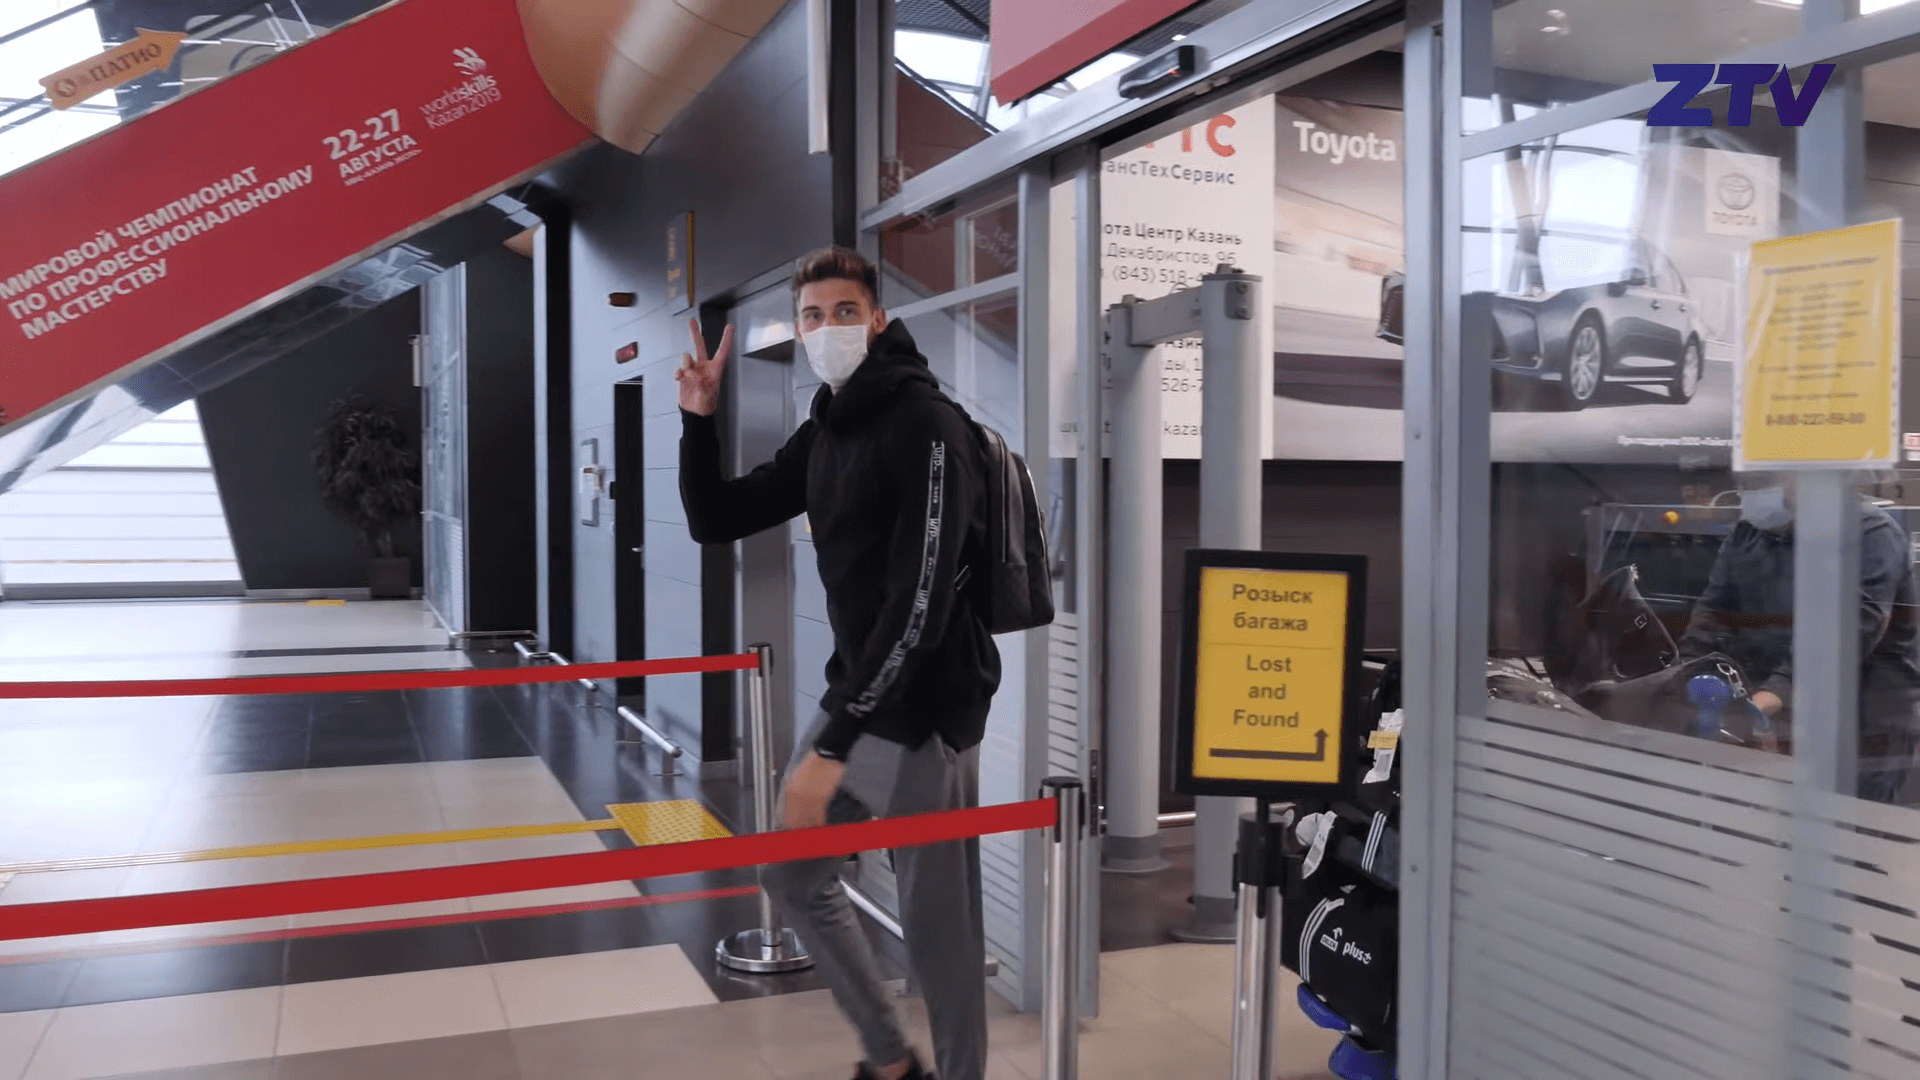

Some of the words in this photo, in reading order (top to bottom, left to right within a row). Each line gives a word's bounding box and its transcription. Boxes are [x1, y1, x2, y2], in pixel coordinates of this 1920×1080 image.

[90, 43, 162, 82] ПАТИО
[419, 75, 497, 115] worldskills
[322, 108, 400, 160] 22-27
[1293, 120, 1397, 164] Toyota
[339, 135, 418, 178] АВГУСТА
[1101, 160, 1235, 185] ансТехСервис
[0, 230, 119, 300] МИРОВОЙ
[117, 166, 260, 240] ЧЕМПИОНАТ
[8, 292, 48, 320] ПО
[47, 165, 314, 301] ПРОФЕССИОНАЛЬНОМУ
[1101, 223, 1131, 236] ота
[1135, 222, 1184, 244] Центр
[1187, 227, 1242, 245] Казань
[1112, 265, 1156, 283] (843)
[20, 258, 168, 339] МАСТЕРСТВУ
[1163, 420, 1202, 436] kaza
[1231, 583, 1314, 603] Розыск
[1233, 611, 1309, 631] багажа
[1246, 655, 1292, 672] Lost
[1248, 684, 1287, 700] and
[1233, 709, 1300, 728] Found
